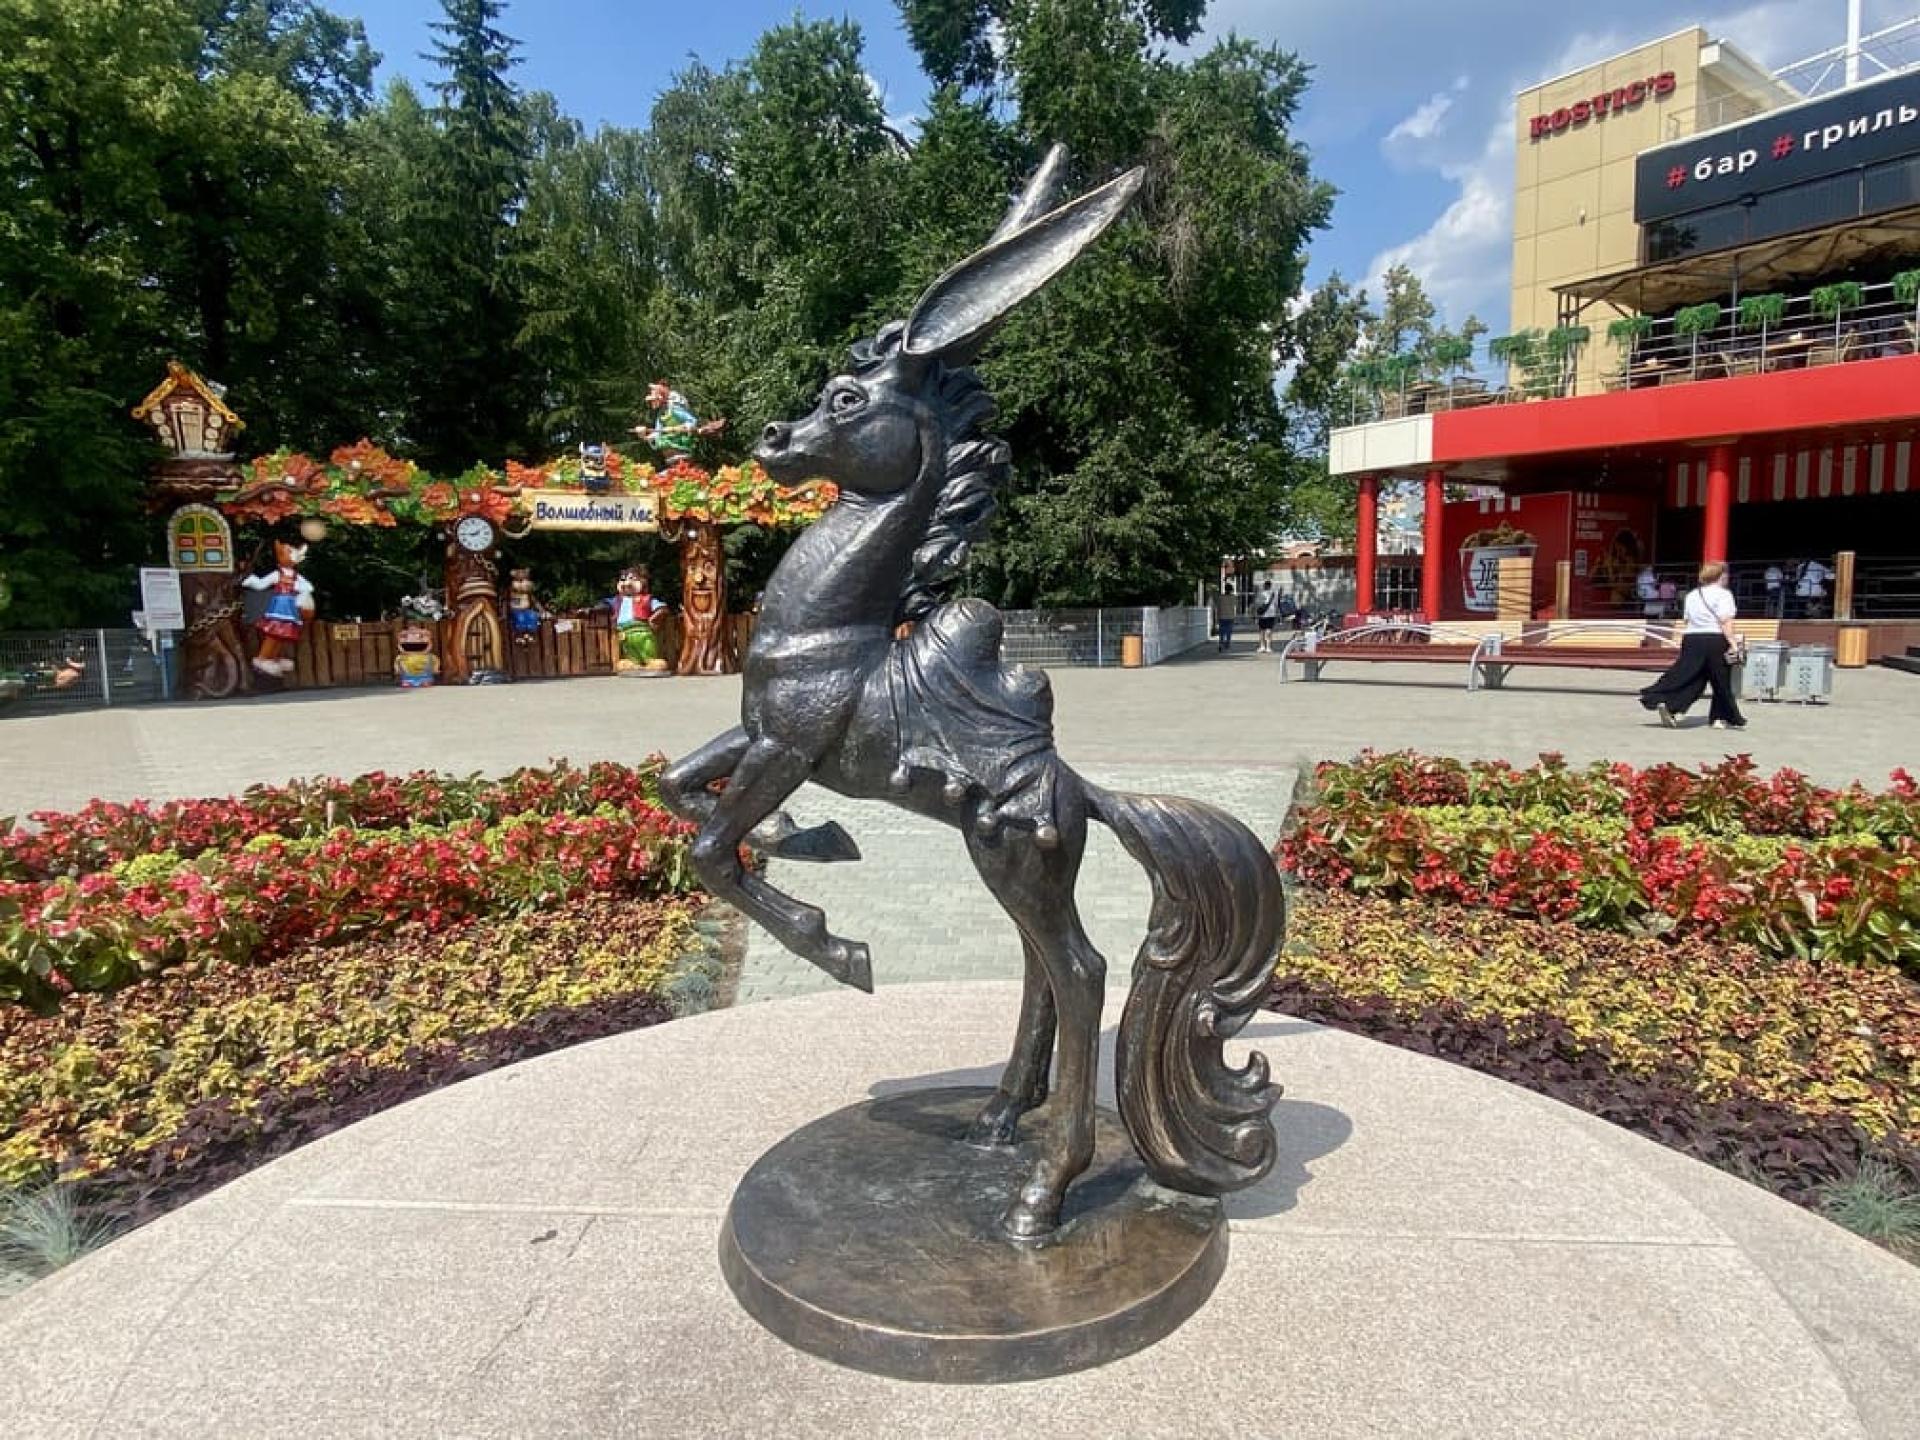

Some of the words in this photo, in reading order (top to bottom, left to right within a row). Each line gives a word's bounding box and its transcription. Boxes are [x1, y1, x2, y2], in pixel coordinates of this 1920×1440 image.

[1529, 71, 1677, 139] ROSTIC'S
[536, 501, 624, 521] Волшебный
[630, 507, 654, 523] лес
